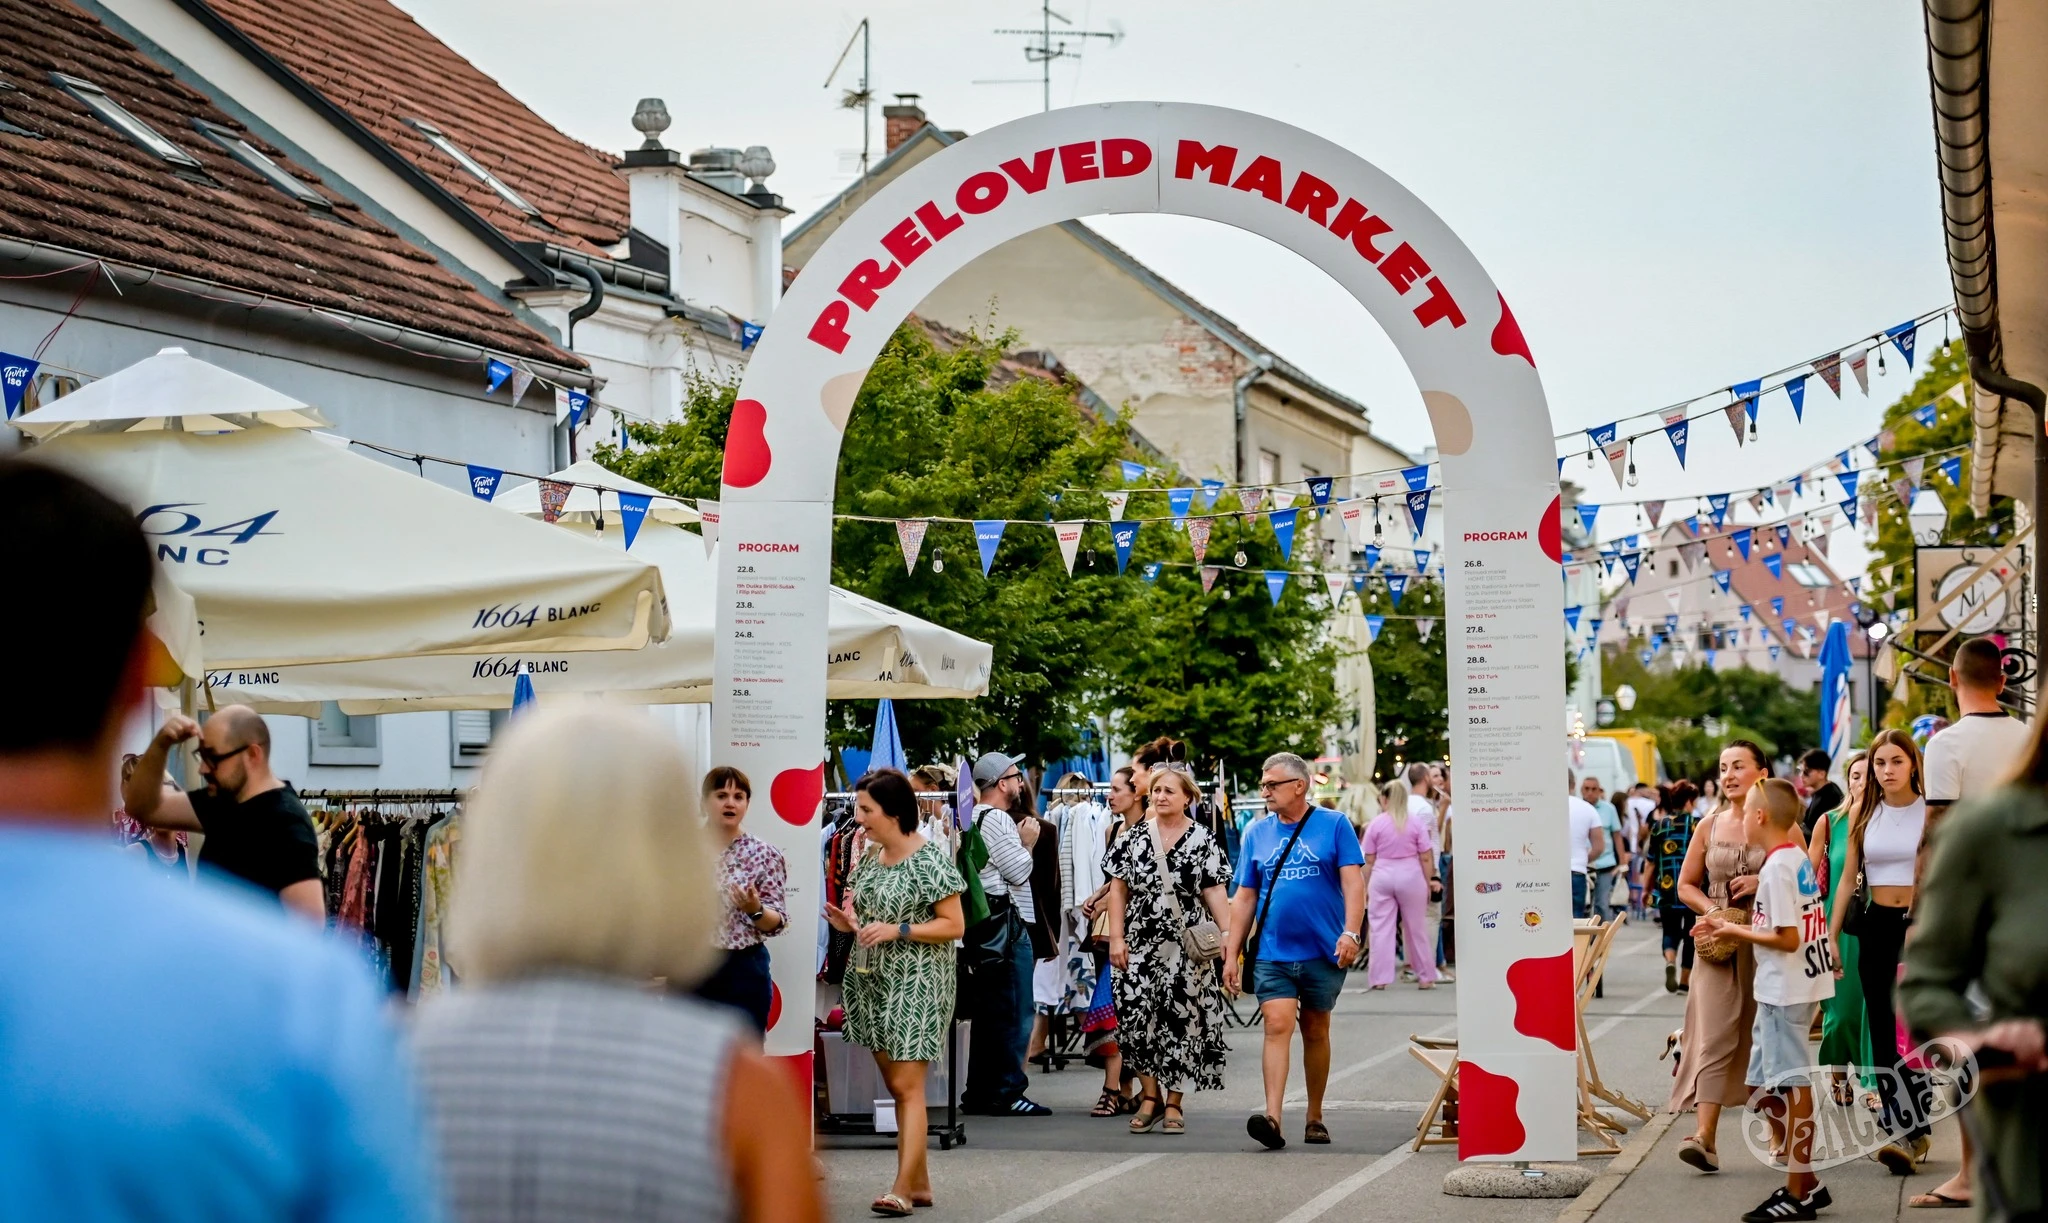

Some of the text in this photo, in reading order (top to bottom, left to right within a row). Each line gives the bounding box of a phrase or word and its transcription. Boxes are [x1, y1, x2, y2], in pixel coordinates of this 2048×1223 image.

[807, 138, 1467, 355] PRELOVED MARKET
[4, 366, 29, 378] Twist
[7, 378, 22, 387] ISO
[473, 476, 496, 488] Twist
[477, 487, 490, 495] ISO
[136, 502, 285, 545] 64
[1115, 530, 1134, 543] Twist
[1464, 531, 1528, 542] PROGRAM
[738, 543, 800, 553] PROGRAM
[1119, 540, 1130, 548] ISO
[1464, 560, 1485, 568] 26.8.
[736, 601, 755, 609] 23.8.
[472, 602, 602, 629] 1664 BLANC
[1466, 626, 1486, 634] 27.8.
[828, 651, 861, 664] LANC
[1467, 656, 1488, 664] 28.8.
[472, 656, 569, 678] 1664 BLANC
[239, 672, 280, 685] BLANC
[1477, 910, 1500, 924] Twist
